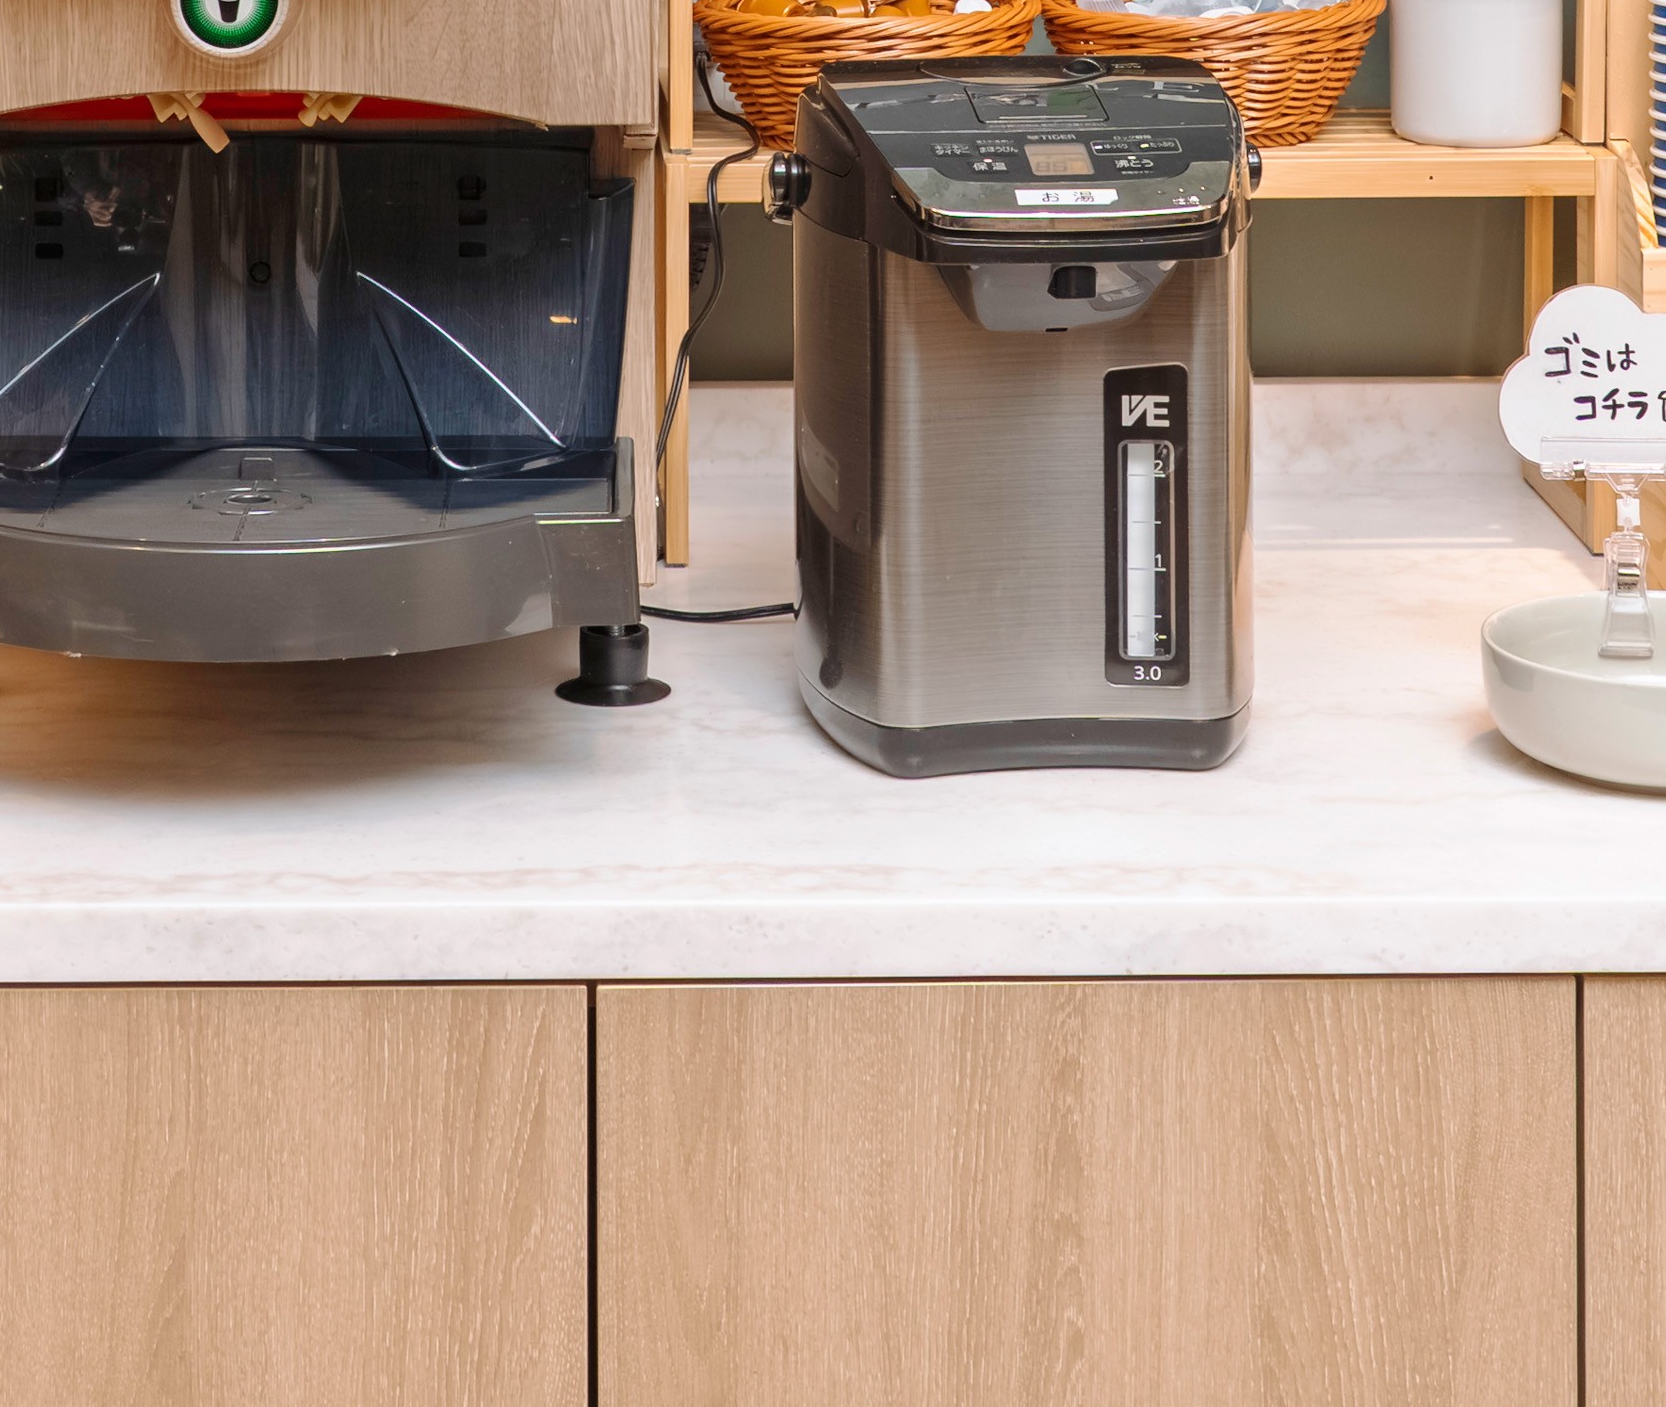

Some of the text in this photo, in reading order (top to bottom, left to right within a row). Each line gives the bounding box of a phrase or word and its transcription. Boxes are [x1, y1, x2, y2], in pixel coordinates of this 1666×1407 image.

[1040, 133, 1077, 141] TIGER
[979, 146, 1019, 154] まほうびん
[973, 161, 1008, 172] 保温
[1115, 158, 1155, 169] 沸とう
[1042, 190, 1095, 204] お湯
[1544, 332, 1638, 378] ゴミは
[1573, 387, 1649, 420] コチラ
[1153, 460, 1164, 474] 2
[1154, 554, 1163, 568] 1
[1133, 665, 1162, 681] 3.0
